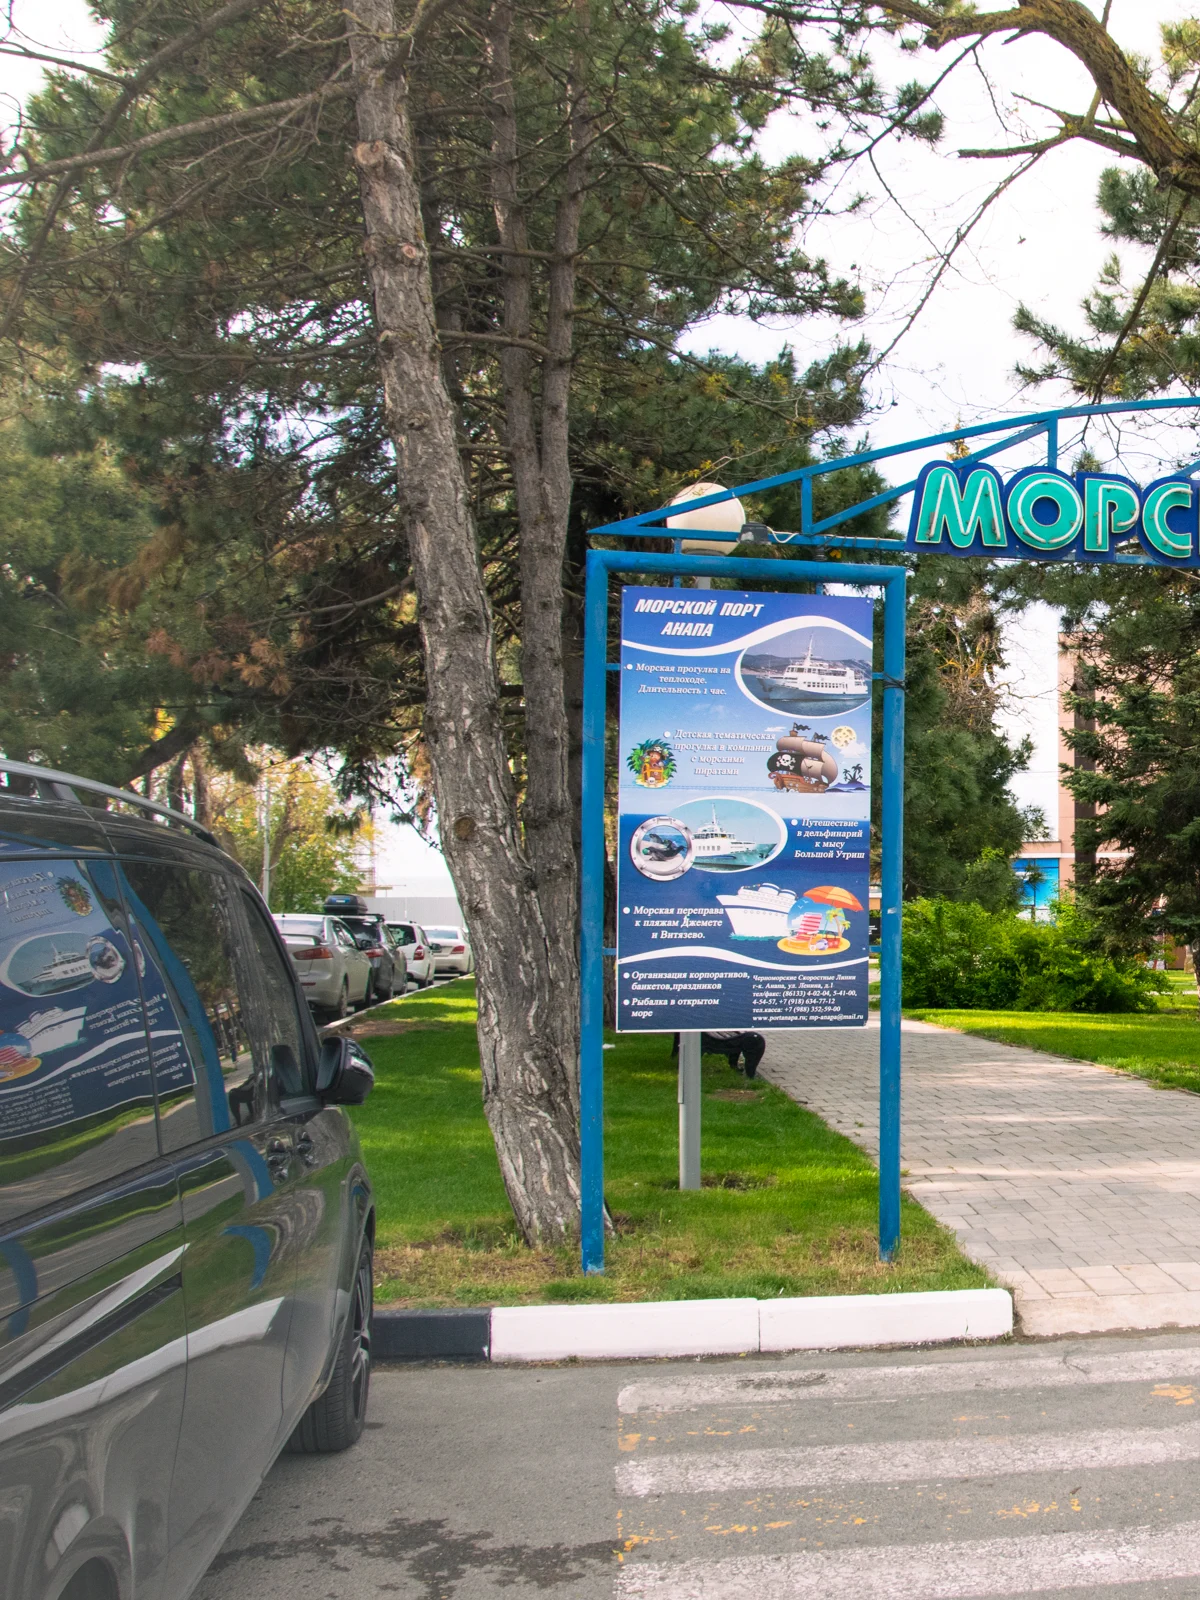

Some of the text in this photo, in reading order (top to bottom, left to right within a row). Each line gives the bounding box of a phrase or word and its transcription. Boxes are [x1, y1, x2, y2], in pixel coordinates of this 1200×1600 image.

[634, 599, 764, 617] МОРСКОЙ ПОРТ
[660, 622, 714, 636] АНАПА
[636, 663, 675, 673] Морская
[677, 666, 718, 674] прогулка
[659, 676, 707, 684] теплоходе.
[638, 684, 701, 694] Длительность
[674, 730, 712, 739] Детская
[674, 743, 716, 752] прогулка
[699, 756, 745, 765] морскими
[694, 768, 739, 776] пиратами
[802, 818, 858, 828] Путешествие
[803, 830, 863, 839] дельфинарий
[822, 841, 845, 849] мысу
[794, 850, 865, 860] Большой Утриш
[633, 906, 724, 916] Морская переправа
[681, 916, 722, 928] Джемете
[660, 931, 705, 939] Витязево.
[631, 971, 750, 980] Организация корпоративов,
[631, 998, 668, 1006] Рыбалка
[677, 998, 720, 1007] открытом
[631, 1010, 653, 1018] море
